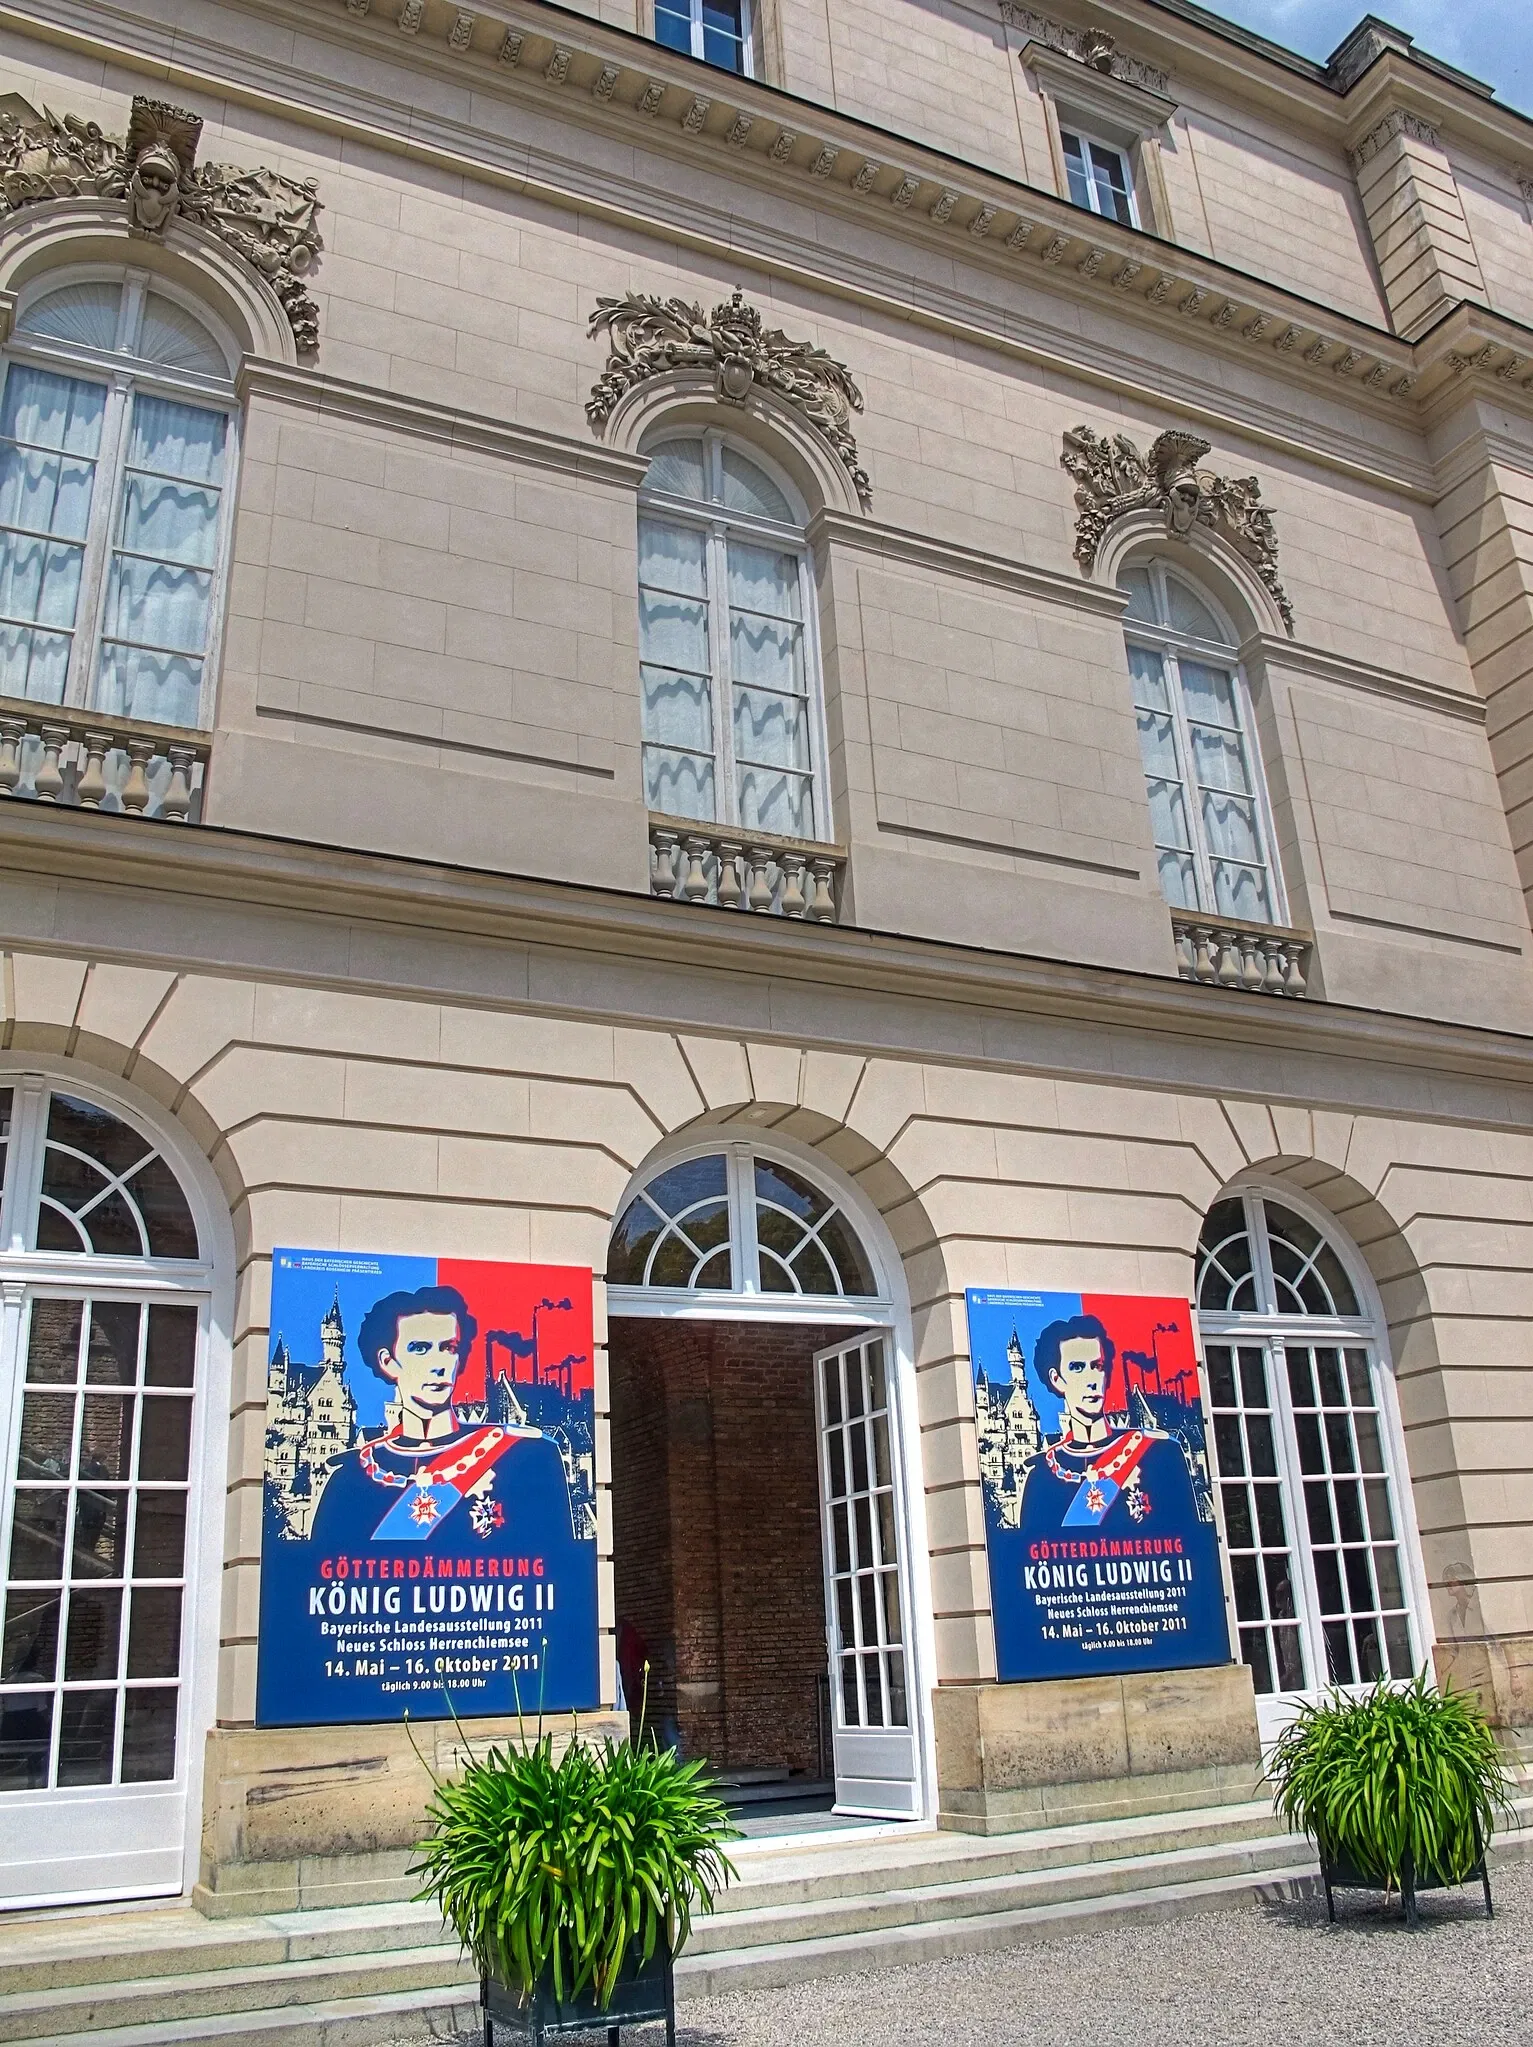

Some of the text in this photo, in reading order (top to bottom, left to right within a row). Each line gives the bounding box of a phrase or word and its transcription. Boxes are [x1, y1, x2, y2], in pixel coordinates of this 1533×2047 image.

[1030, 1538, 1183, 1559] GÖTTERDÄMMERUNG
[321, 1556, 545, 1579] GÖTTERDÄMMERUNG
[1024, 1559, 1192, 1589] KÖNIG LUDWIG II
[309, 1581, 554, 1615] KÖNIG LUDWIG II
[1036, 1587, 1186, 1606] Bayerische Landesausstellung 2011
[1048, 1604, 1178, 1619] Neues Schloss Herrenchiemsee
[321, 1618, 543, 1637] Bayerische Landesausstellung 2011
[1042, 1626, 1059, 1639] 14.
[1063, 1624, 1083, 1637] Mai
[1096, 1623, 1113, 1635] 16.
[1116, 1619, 1159, 1634] Oktober
[1162, 1617, 1187, 1630] 2011
[337, 1636, 528, 1653] Neues Schloss Herrenchiemsee
[325, 1661, 350, 1677] 14.
[356, 1659, 385, 1675] Mai
[407, 1658, 429, 1674] 16.
[435, 1656, 497, 1673] Oktober
[502, 1655, 538, 1671] 2011
[381, 1681, 410, 1692] täglich
[414, 1680, 431, 1690] 9.00
[447, 1679, 470, 1689] 18.00
[472, 1678, 486, 1688] Uhr
